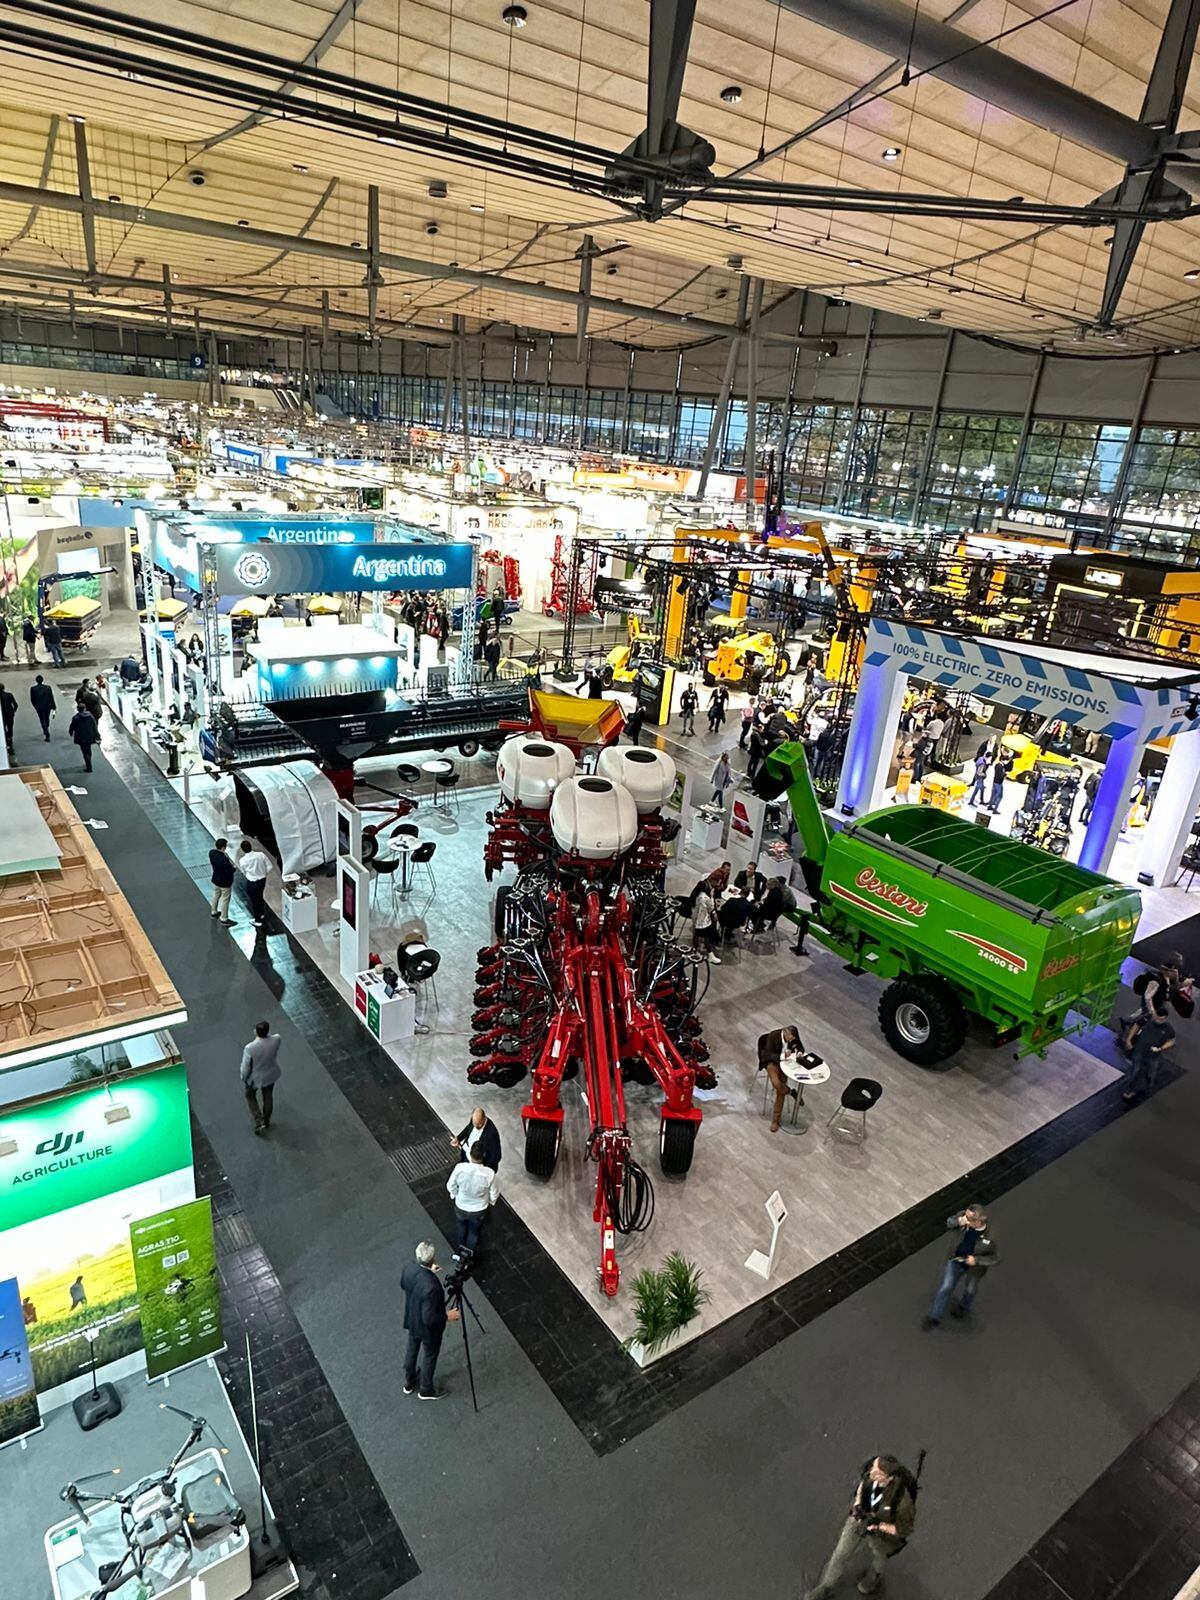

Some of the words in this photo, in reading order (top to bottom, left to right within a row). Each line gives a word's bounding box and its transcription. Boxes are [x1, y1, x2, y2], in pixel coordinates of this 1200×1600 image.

[195, 356, 202, 366] 9
[267, 526, 355, 544] Argentin
[353, 555, 446, 583] Argentina
[892, 642, 920, 659] 100%
[923, 651, 982, 678] ELECTRIC.
[982, 668, 1023, 688] ZERO
[1026, 680, 1110, 715] EMISSIONS.
[855, 866, 929, 917] Cestari
[978, 949, 1006, 968] 24000
[12, 1145, 113, 1185] AGRICULTURE
[137, 1239, 165, 1255] AGRAS
